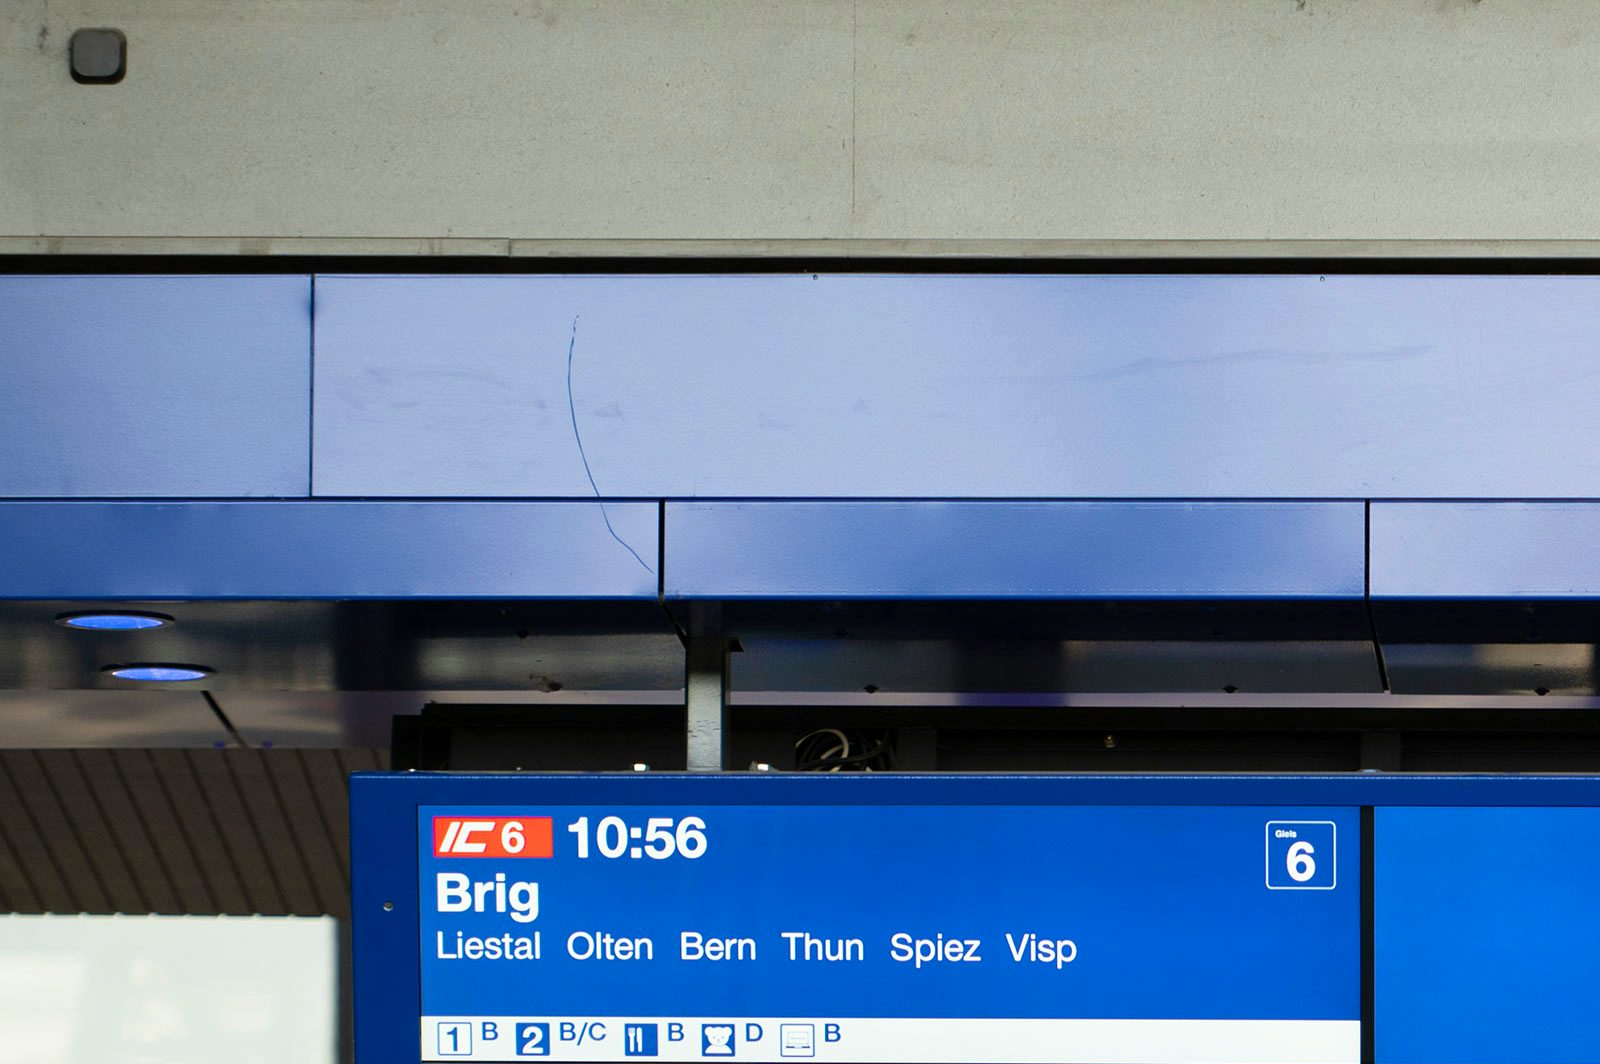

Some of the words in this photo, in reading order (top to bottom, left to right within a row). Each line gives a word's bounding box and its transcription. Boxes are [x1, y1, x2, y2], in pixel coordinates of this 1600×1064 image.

[439, 821, 496, 853] IC
[501, 821, 525, 854] 6
[568, 816, 708, 860] 10:56
[1275, 829, 1297, 838] Gleis
[1286, 841, 1316, 882] 6
[436, 872, 539, 923] Brig
[436, 931, 541, 960] Liestal
[567, 931, 653, 960] Olten
[680, 931, 757, 960] Bern
[781, 932, 864, 961] Thun
[890, 933, 982, 968] Spiez
[1005, 933, 1078, 969] Visp
[447, 1026, 458, 1052] 1
[481, 1022, 499, 1041] B
[522, 1026, 544, 1054] 2
[560, 1022, 607, 1046] B/C
[668, 1023, 685, 1041] B
[746, 1023, 763, 1042] D
[824, 1023, 841, 1042] B
